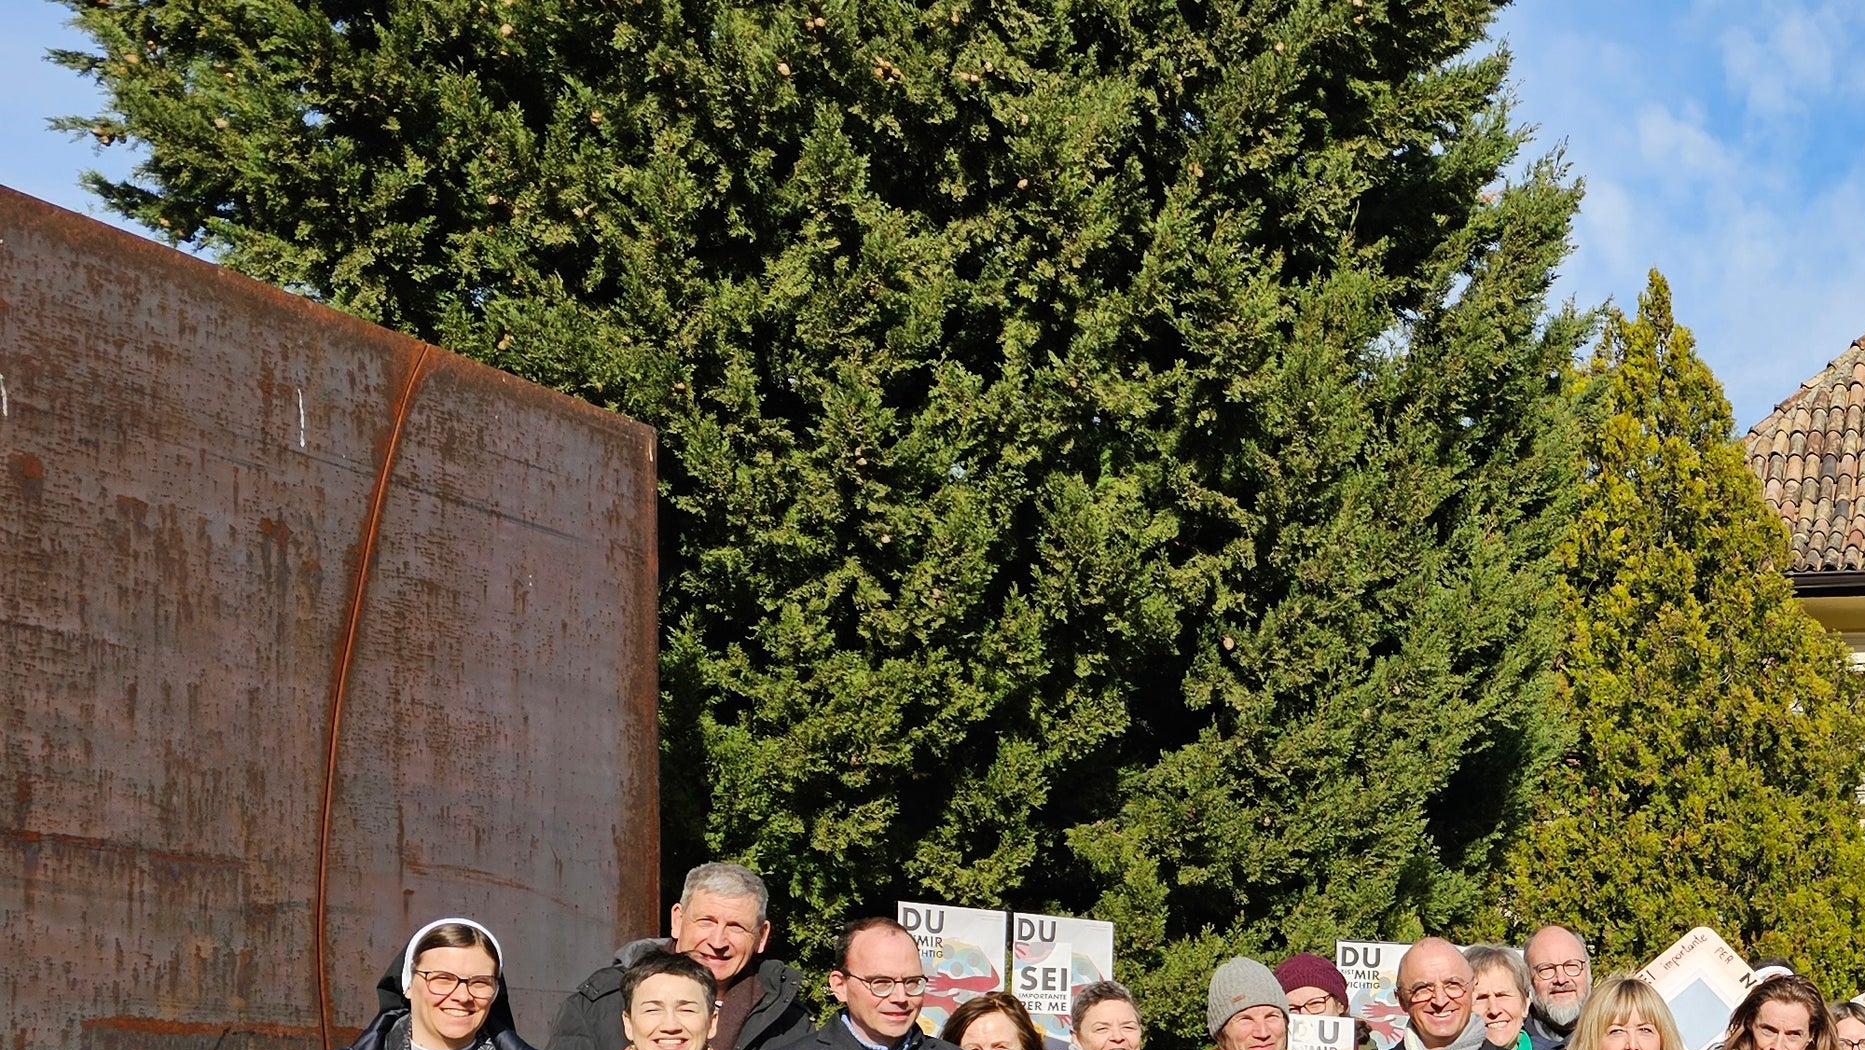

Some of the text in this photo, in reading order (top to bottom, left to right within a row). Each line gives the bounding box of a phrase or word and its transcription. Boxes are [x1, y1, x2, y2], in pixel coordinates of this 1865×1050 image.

[903, 907, 944, 934] DU
[1017, 918, 1056, 942] DU
[1341, 946, 1381, 968] DU
[1660, 934, 1708, 971] importante
[1714, 946, 1735, 965] PER
[1020, 966, 1067, 991] SEI
[1346, 981, 1380, 989] ICHTIG
[1354, 970, 1380, 980] MIR
[1047, 1001, 1067, 1011] ME
